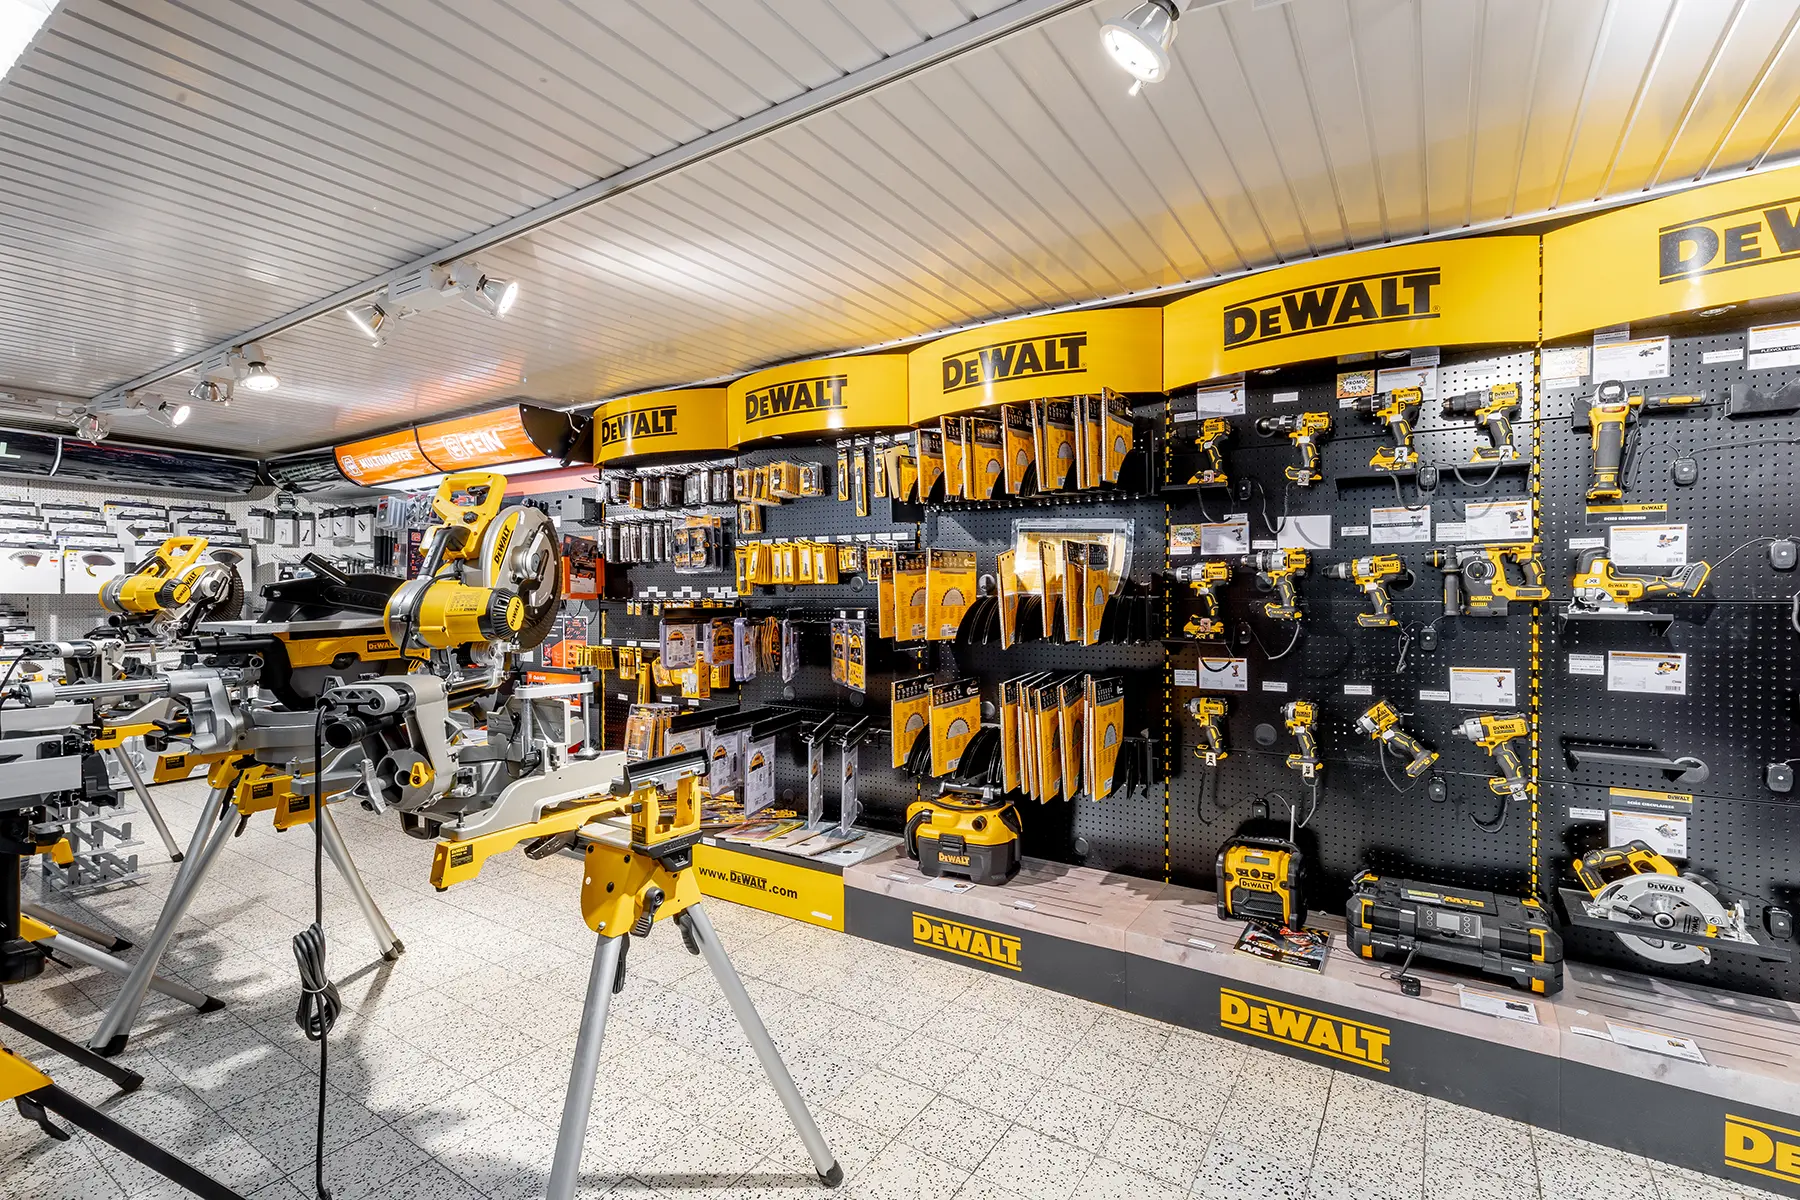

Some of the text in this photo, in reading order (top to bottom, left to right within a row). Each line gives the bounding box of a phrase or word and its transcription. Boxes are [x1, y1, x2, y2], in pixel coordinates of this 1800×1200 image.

[1225, 273, 1440, 346] DEWALT
[943, 336, 1086, 388] DEWALT
[746, 379, 847, 421] DEWALT
[460, 430, 506, 456] FEIN
[602, 409, 677, 443] DEWALT
[359, 450, 414, 469] MULTIMASTER
[494, 526, 512, 564] DEWALT
[510, 600, 521, 628] DEWALT
[938, 852, 970, 866] DEWALT
[1241, 880, 1271, 890] DEWALT
[1647, 882, 1685, 893] DEWALT
[912, 916, 1022, 966] DEWALT
[1220, 994, 1391, 1064] DEWALT
